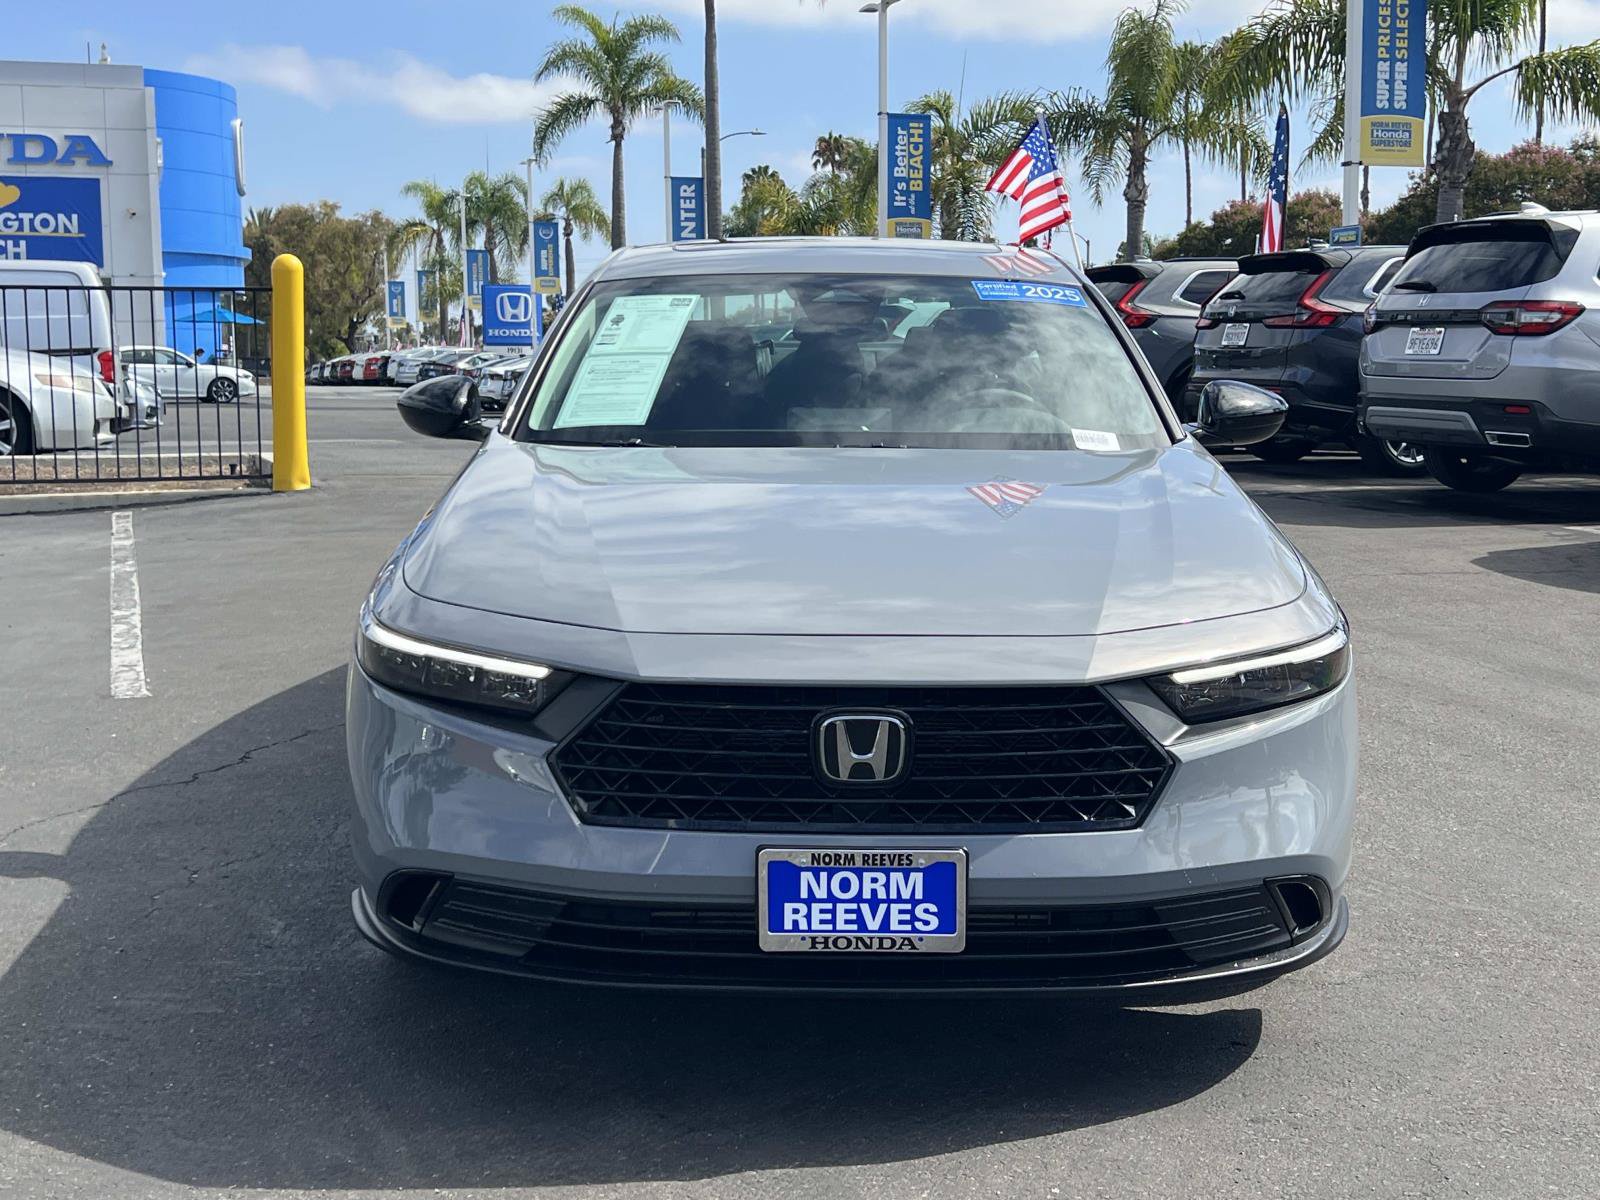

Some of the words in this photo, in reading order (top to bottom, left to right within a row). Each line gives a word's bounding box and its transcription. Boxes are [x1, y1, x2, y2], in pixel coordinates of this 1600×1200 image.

[1377, 0, 1391, 58] PRICES
[1376, 60, 1390, 109] SUPER
[1394, 61, 1408, 110] SUPER
[1370, 139, 1412, 147] SUPERSTORE
[1373, 129, 1410, 138] Honda
[0, 133, 113, 167] DA
[893, 127, 907, 178] Better
[909, 122, 924, 191] BEACH!
[893, 182, 907, 206] It's
[680, 184, 696, 238] NTER
[1022, 286, 1080, 301] 2025
[811, 852, 856, 867] NORM
[861, 852, 914, 868] REEVES
[800, 871, 924, 900] NORM
[783, 903, 940, 932] REEVES
[808, 936, 920, 951] HONDA
